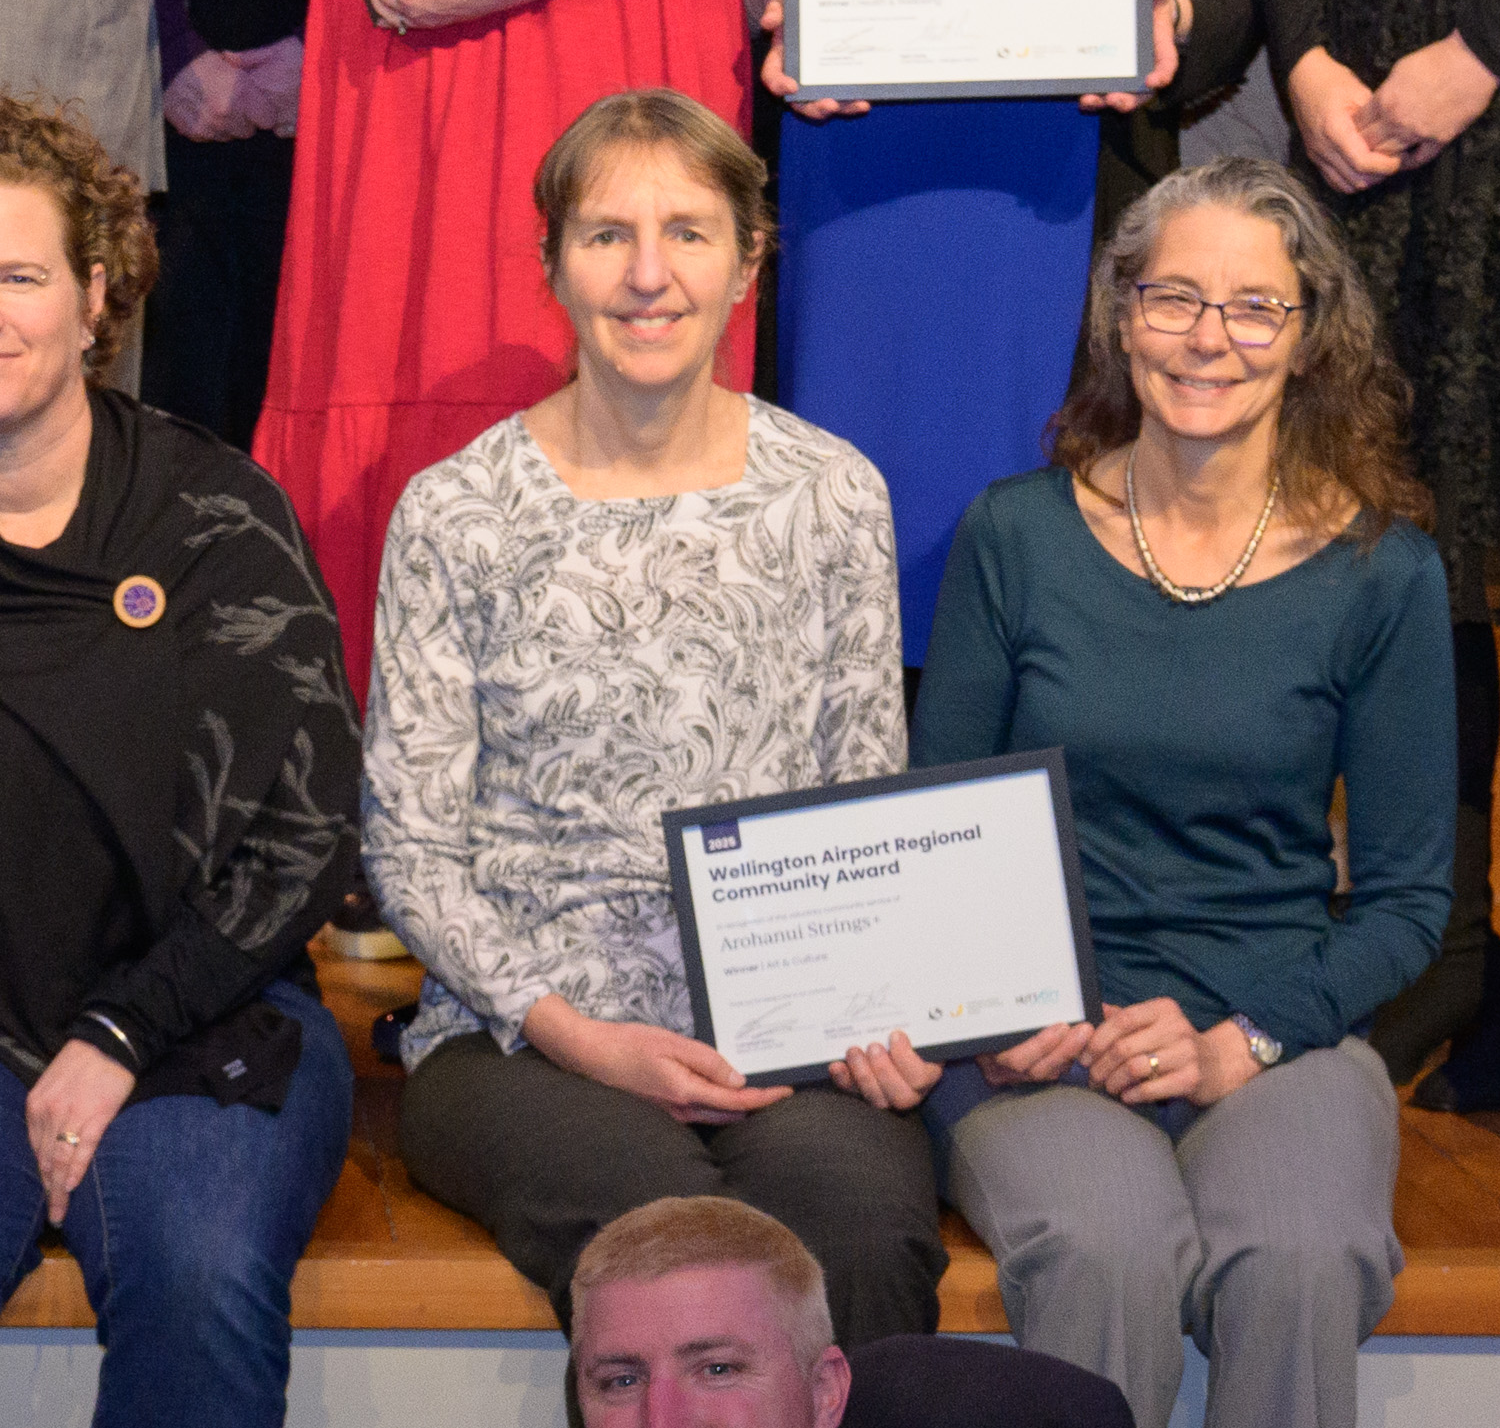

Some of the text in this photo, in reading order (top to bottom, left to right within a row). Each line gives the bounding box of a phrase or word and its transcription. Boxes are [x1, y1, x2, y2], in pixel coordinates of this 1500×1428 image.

[708, 825, 982, 882] Wellington Airport Regional
[712, 860, 900, 903] Community Award
[720, 924, 804, 953] Arohanui
[807, 916, 872, 938] Strings
[724, 964, 759, 976] Winner
